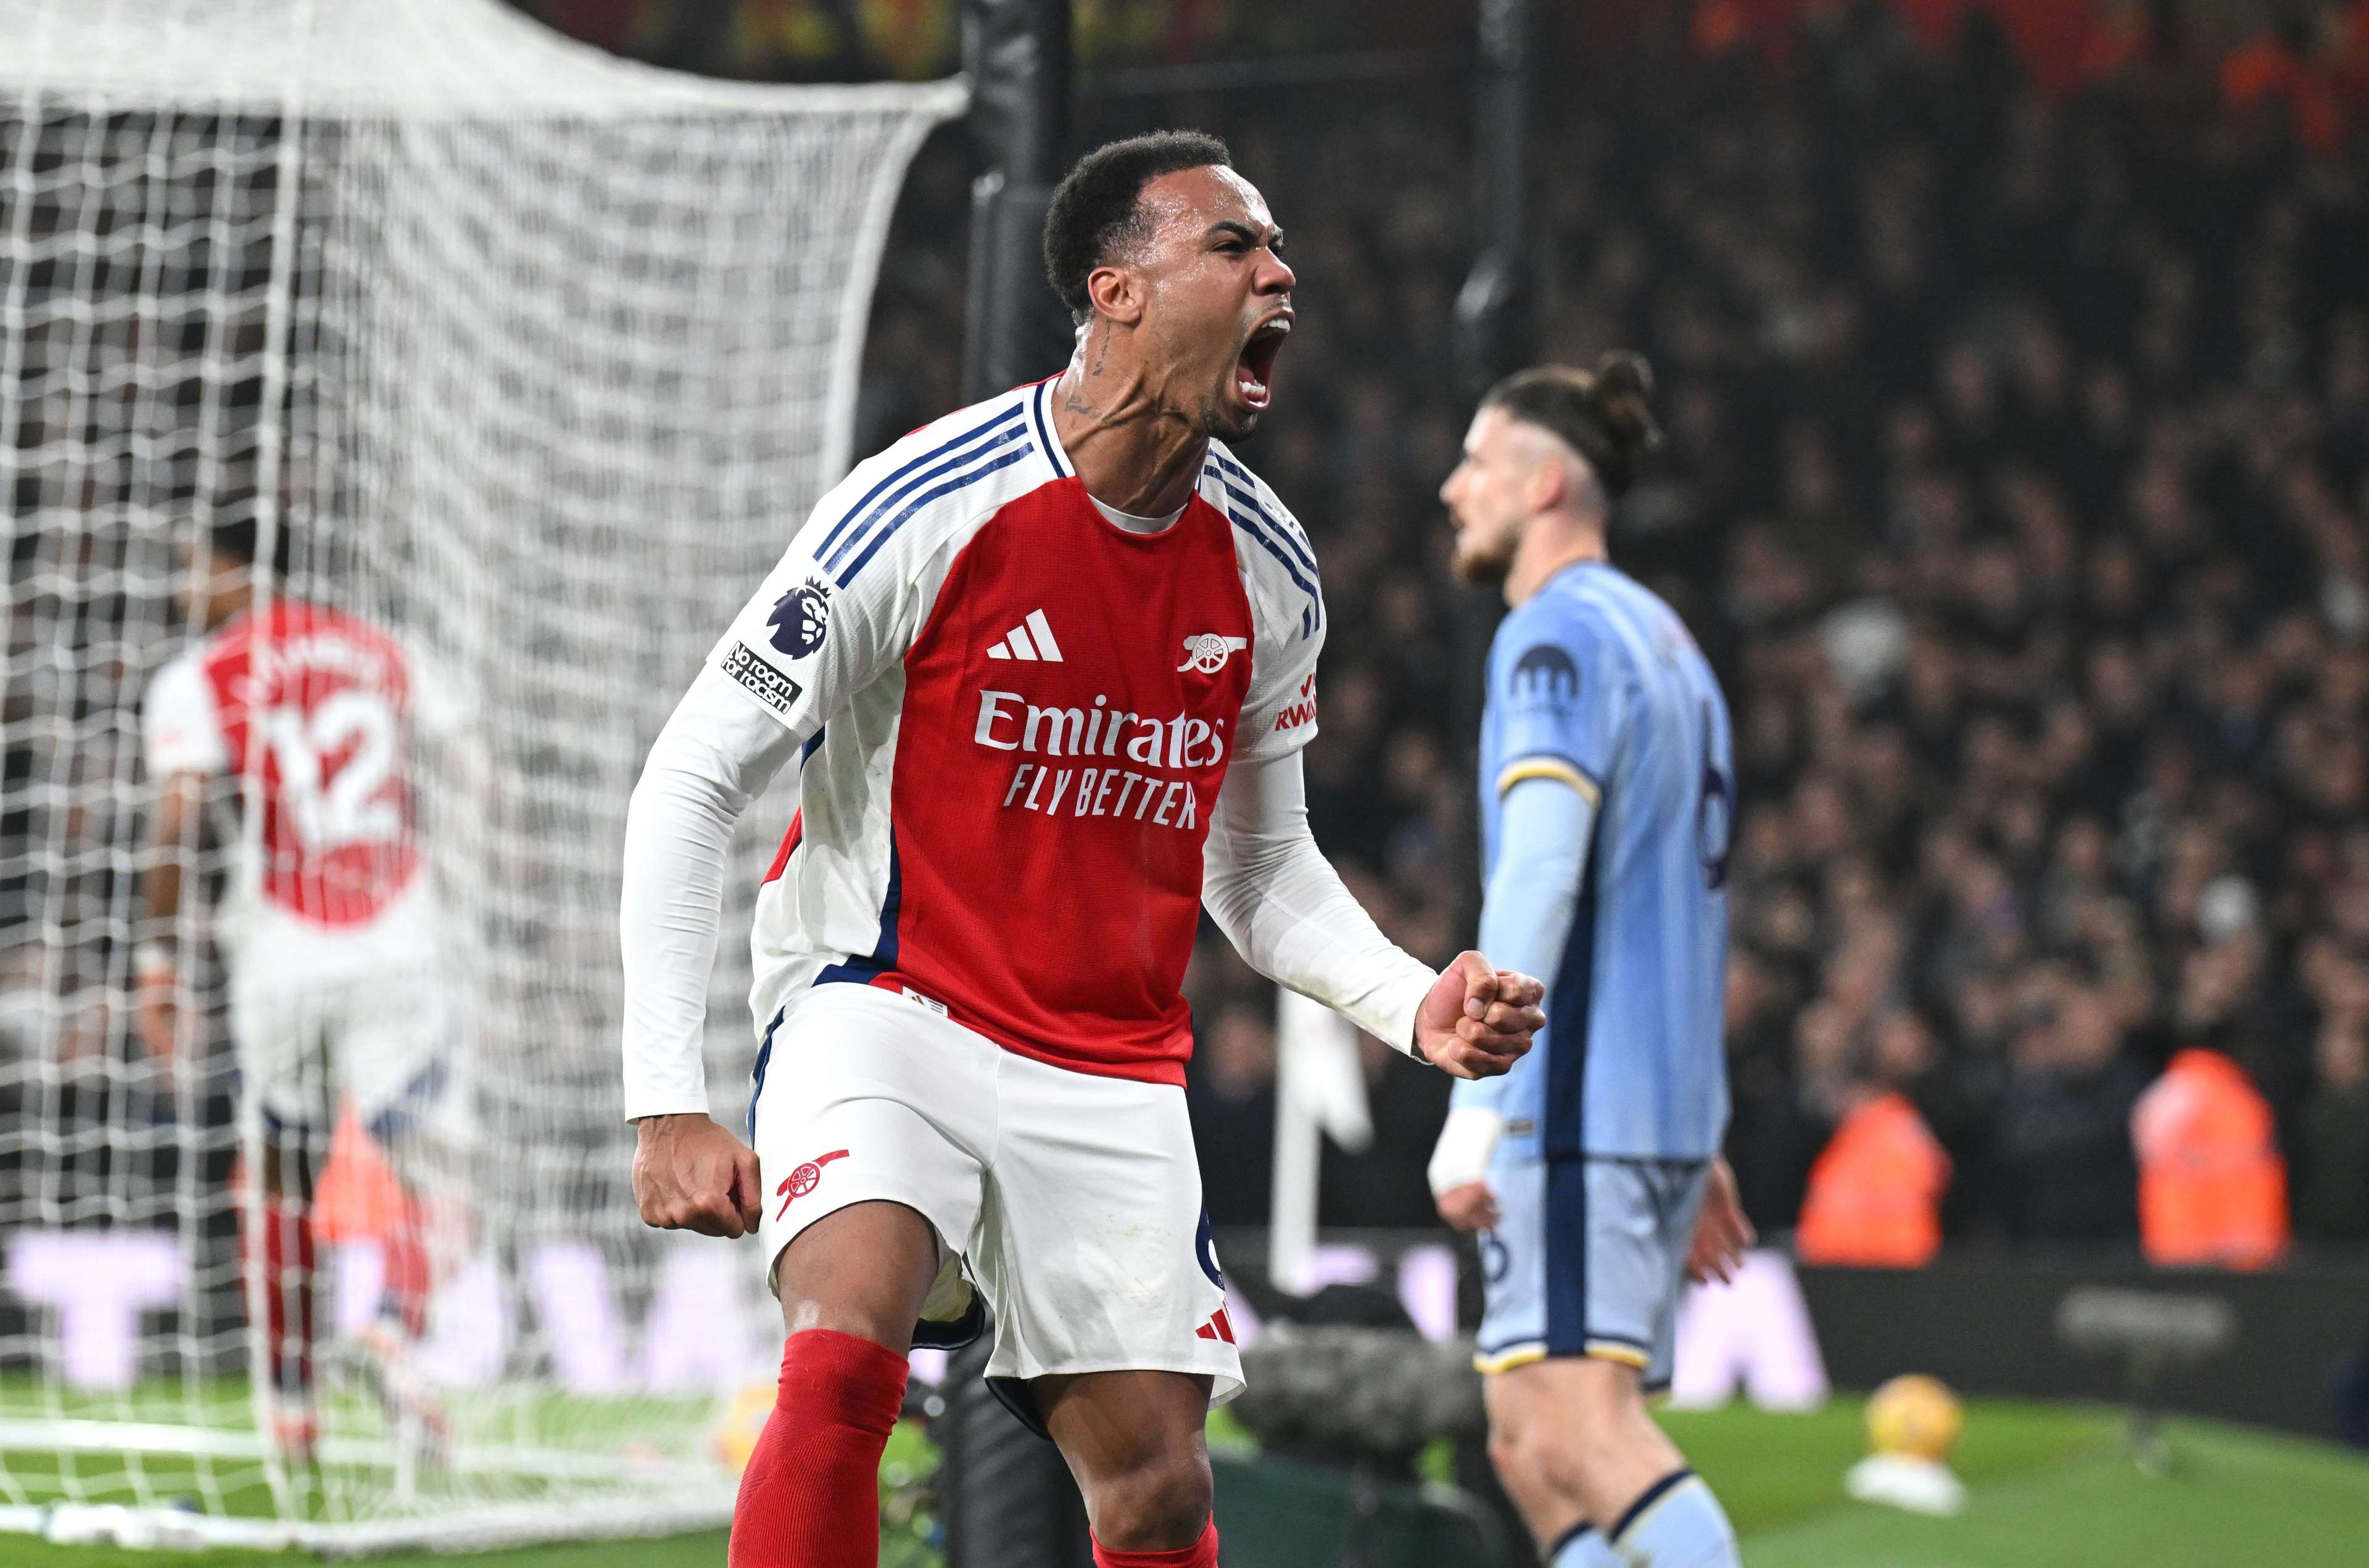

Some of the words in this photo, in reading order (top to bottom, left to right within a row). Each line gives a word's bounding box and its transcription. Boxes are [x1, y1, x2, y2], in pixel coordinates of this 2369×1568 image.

[721, 654, 743, 677] for
[739, 671, 791, 714] racism
[728, 642, 750, 666] No
[748, 659, 793, 697] room
[974, 689, 1224, 769] Emirates
[1275, 694, 1317, 732] RWA
[257, 690, 401, 851] 12
[1003, 764, 1073, 815] FLY
[1075, 768, 1196, 830] BETTER
